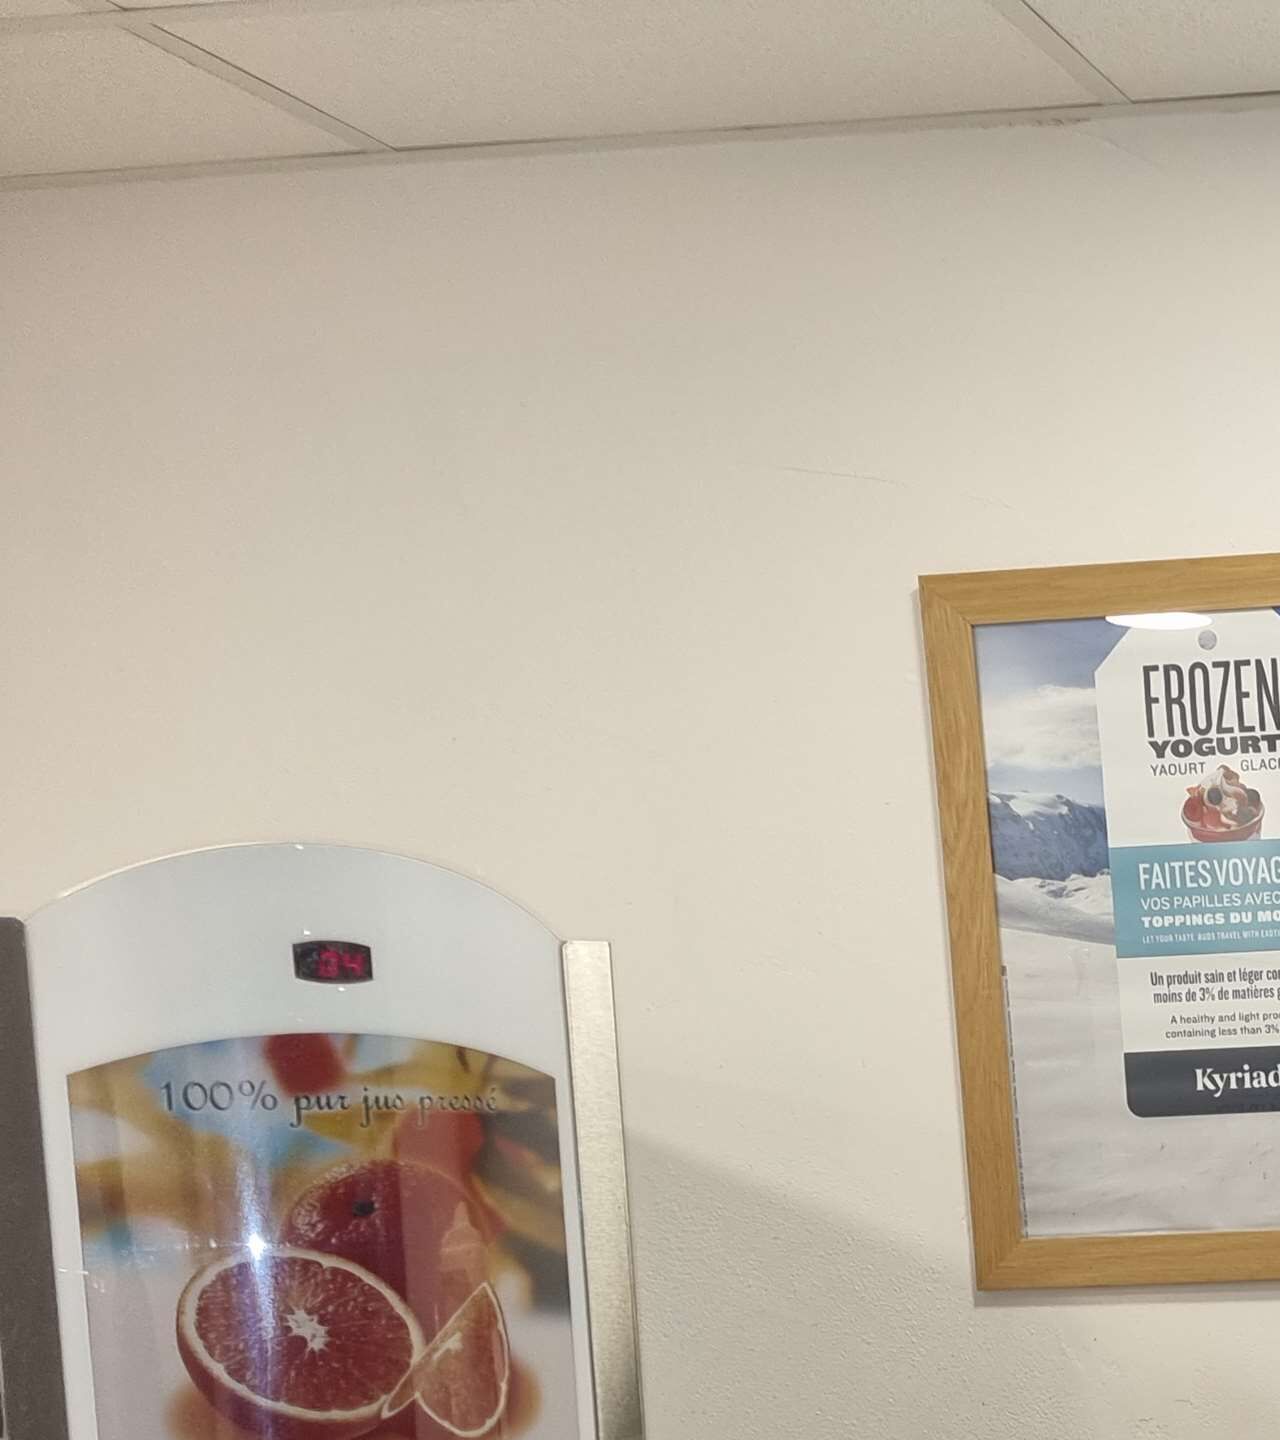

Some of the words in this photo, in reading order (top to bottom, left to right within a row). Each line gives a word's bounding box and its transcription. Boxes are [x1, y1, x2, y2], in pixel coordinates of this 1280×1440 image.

[1150, 762, 1206, 777] YAOURT
[1138, 860, 1212, 890] FAITES
[1140, 897, 1170, 911] VOS
[1173, 893, 1241, 909] PAPILLES
[1141, 913, 1225, 928] TOPPINGS
[1230, 911, 1253, 924] DU
[1142, 935, 1154, 944] LET
[1216, 930, 1240, 940] TRAVEL
[1242, 930, 1259, 939] WITH
[1150, 971, 1164, 986] Un
[1166, 970, 1202, 988] produit
[1204, 969, 1225, 983] sain
[1227, 969, 1237, 982] et
[1239, 968, 1263, 984] léger
[1153, 990, 1183, 1003] moins
[1185, 989, 1197, 1002] de
[1199, 987, 1215, 1001] 3%
[1218, 987, 1230, 1000] de
[1232, 984, 1275, 999] matières
[1170, 1015, 1178, 1025] A
[1180, 1013, 1216, 1025] healthy
[1218, 1012, 1236, 1022] and
[1239, 1011, 1260, 1023] light
[1165, 1028, 1216, 1038] containing
[1218, 1026, 1238, 1035] less
[1240, 1025, 1262, 1035] than
[1264, 1024, 1280, 1034] 3%
[160, 1080, 278, 1112] 100%
[289, 1095, 351, 1128] pur
[359, 1085, 405, 1128] jus
[416, 1087, 498, 1130] pressé
